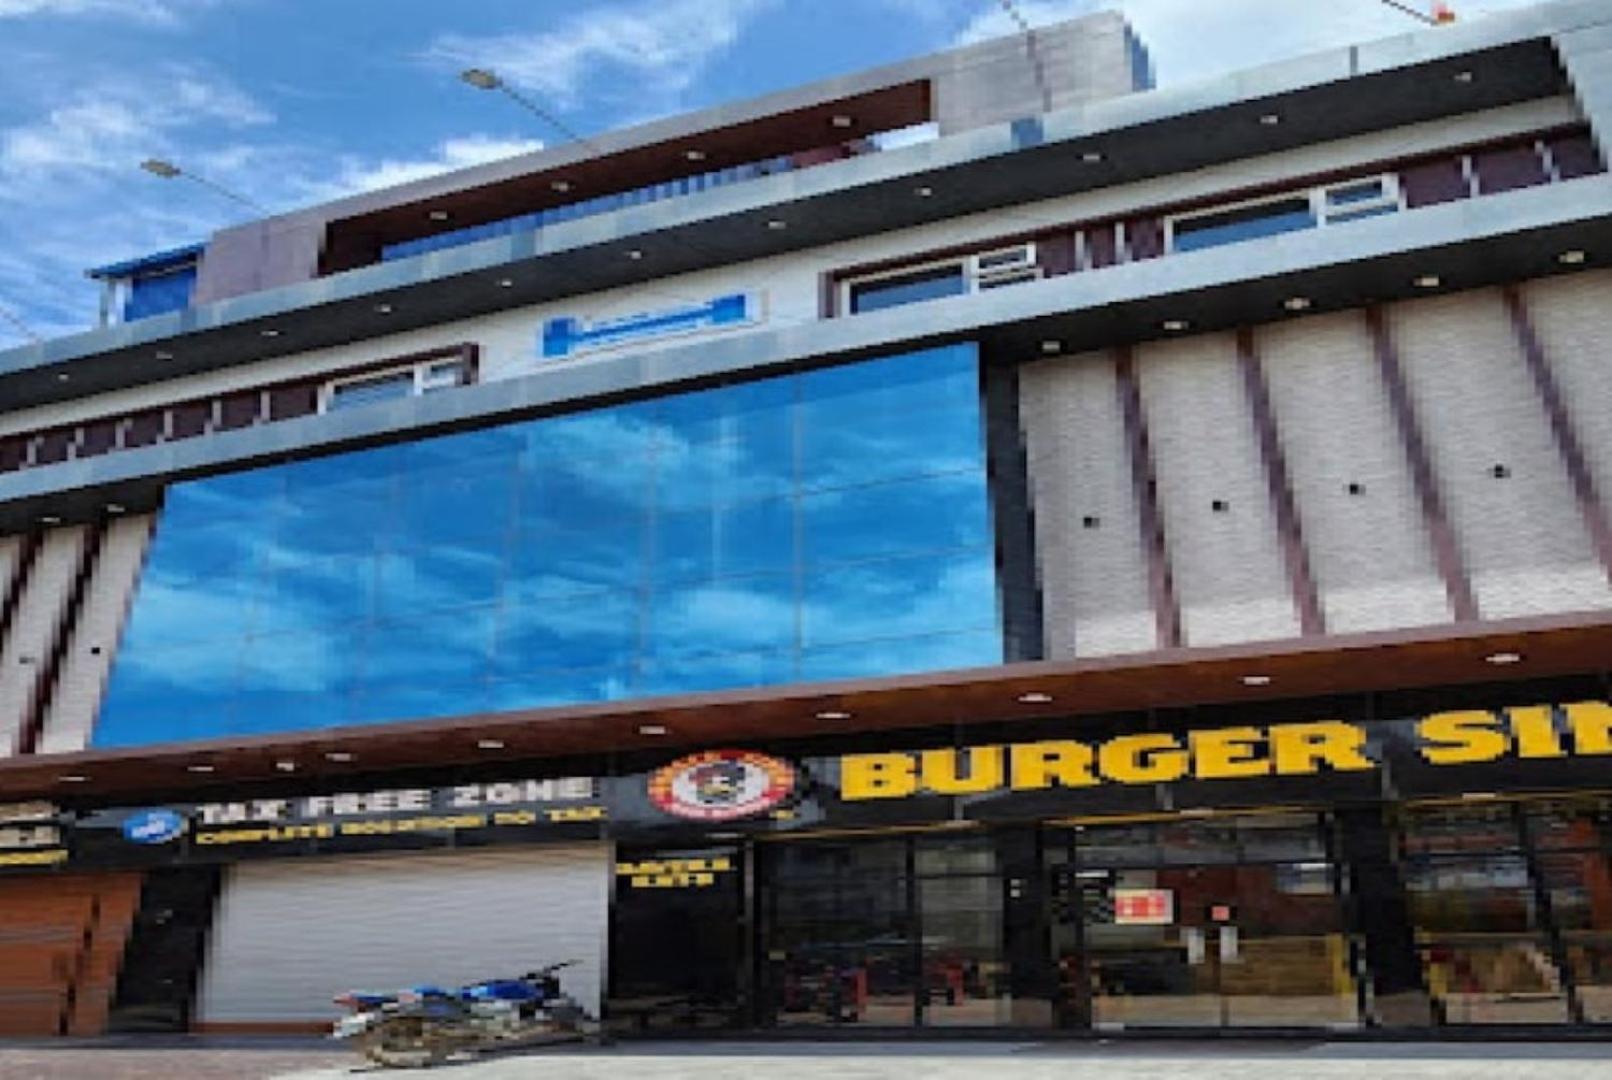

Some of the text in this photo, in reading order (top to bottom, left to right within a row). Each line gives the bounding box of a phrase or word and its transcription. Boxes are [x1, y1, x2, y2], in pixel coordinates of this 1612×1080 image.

[841, 720, 1374, 799] BURGER
[307, 789, 431, 819] FREE
[452, 776, 593, 808] ZONE
